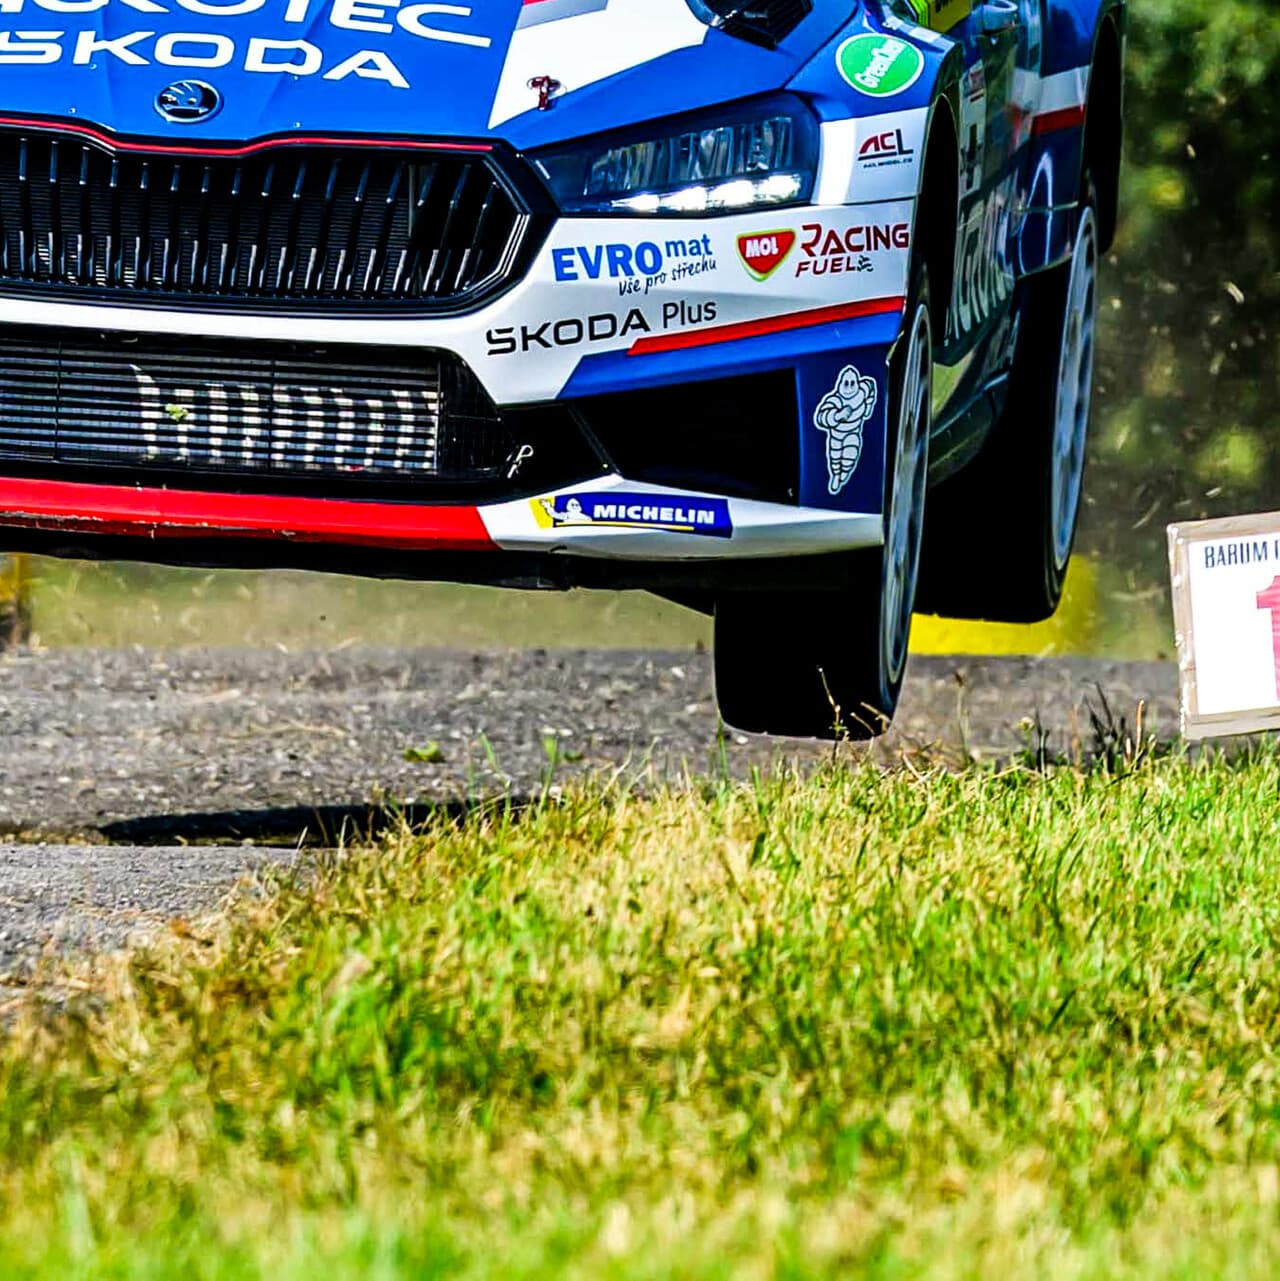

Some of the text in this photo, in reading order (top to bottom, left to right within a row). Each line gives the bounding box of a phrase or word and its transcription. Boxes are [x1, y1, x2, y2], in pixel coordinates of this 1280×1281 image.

[859, 128, 914, 156] ACL
[745, 236, 779, 259] MOL
[800, 223, 909, 258] RACING
[552, 233, 713, 282] EVRO mat
[644, 272, 667, 295] pro
[662, 300, 717, 329] Plus
[593, 504, 715, 525] MICHELIN
[1204, 541, 1268, 569] BARUM
